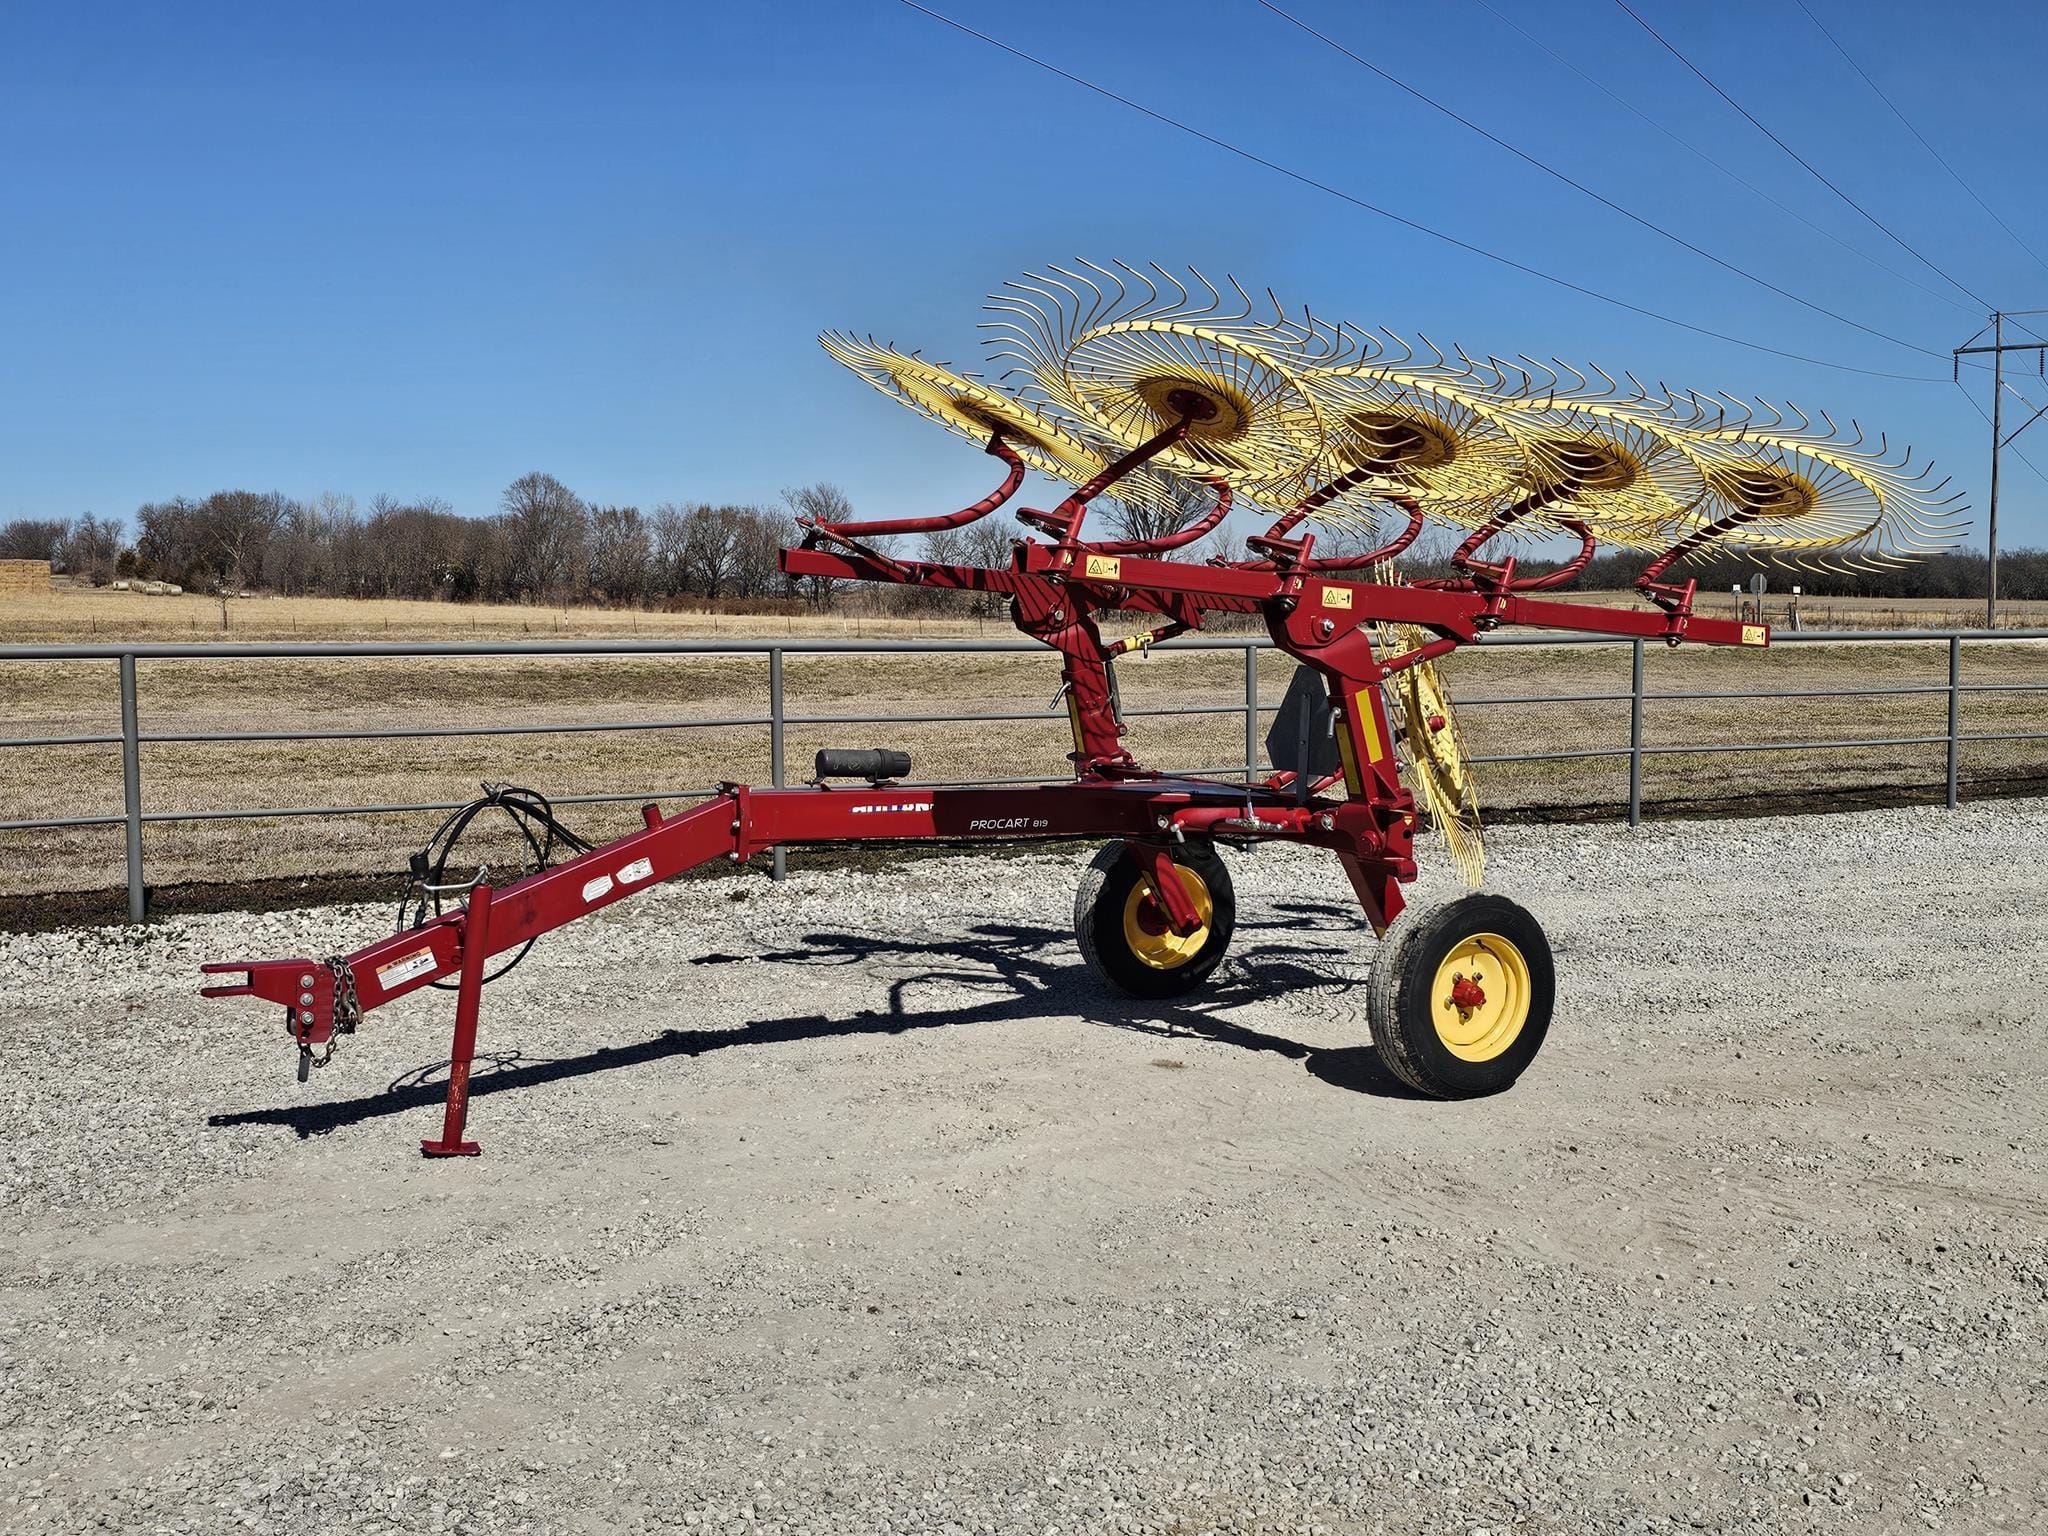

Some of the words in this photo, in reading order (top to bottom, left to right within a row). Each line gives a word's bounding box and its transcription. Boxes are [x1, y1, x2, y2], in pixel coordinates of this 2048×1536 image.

[969, 817, 1030, 831] PROCART
[1032, 819, 1049, 828] 819
[392, 951, 421, 966] WARNING
